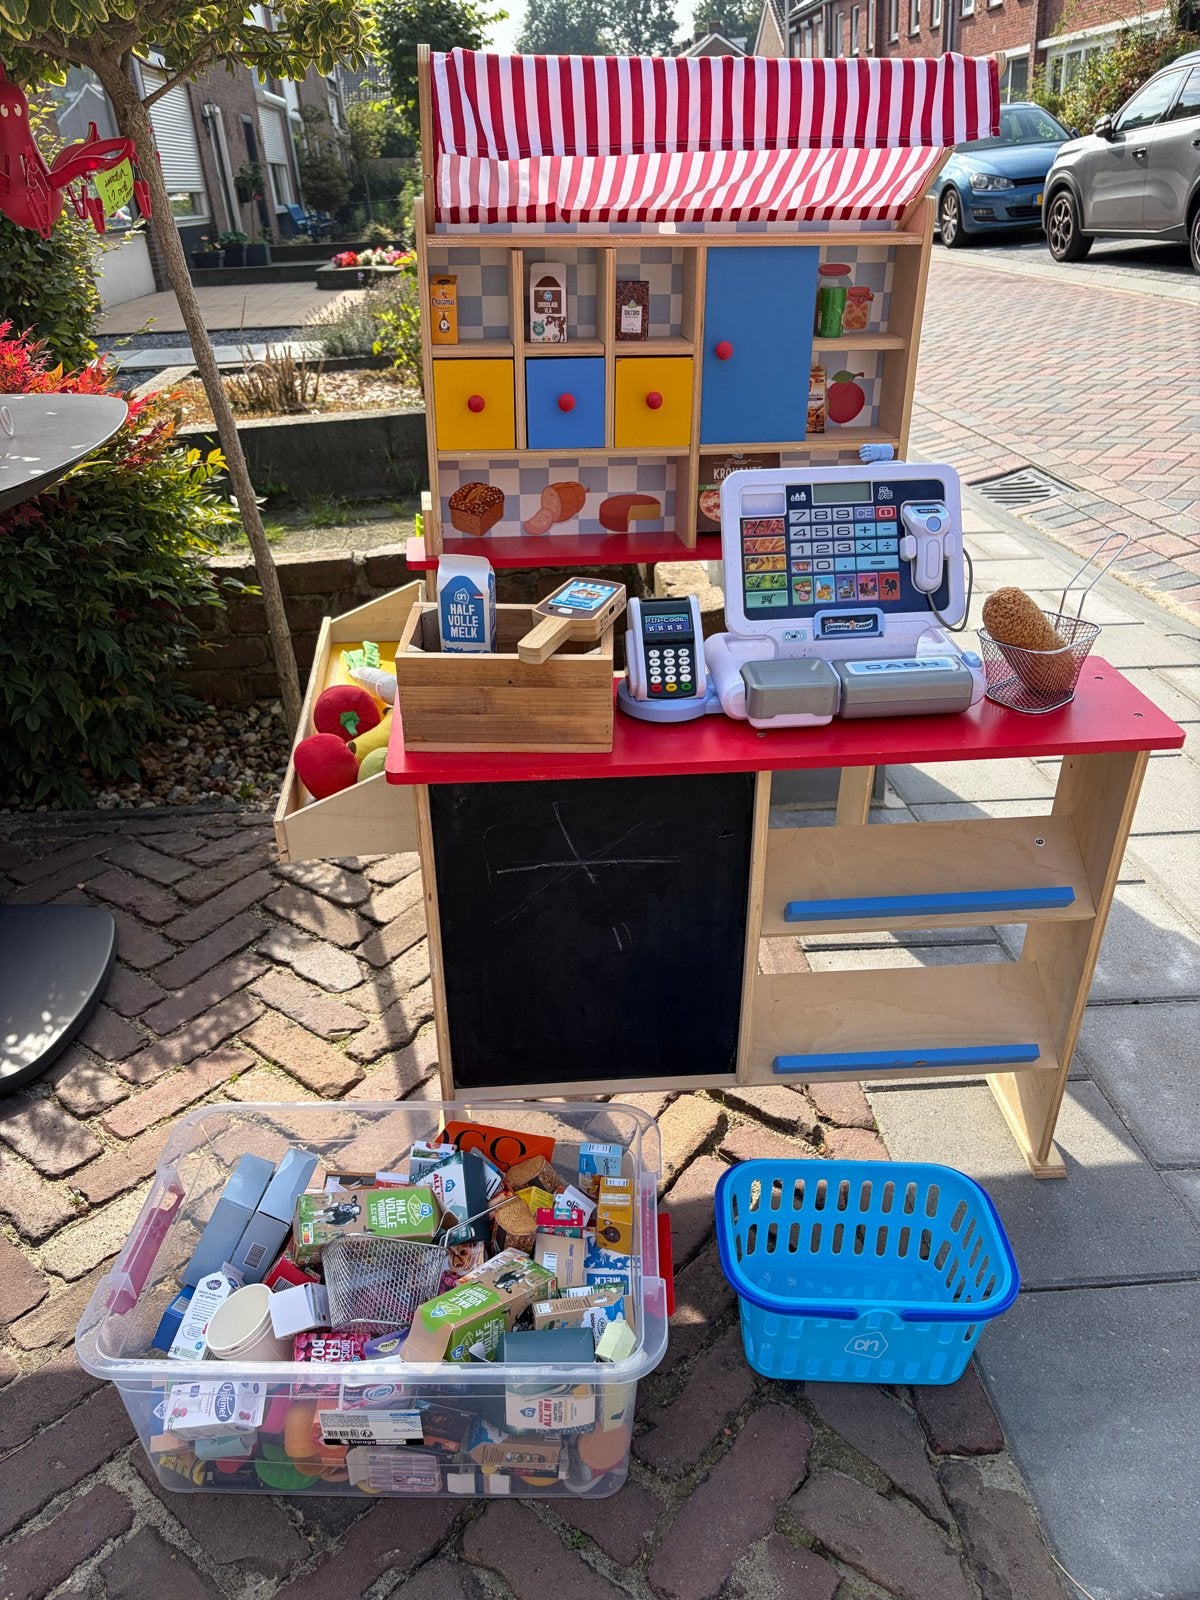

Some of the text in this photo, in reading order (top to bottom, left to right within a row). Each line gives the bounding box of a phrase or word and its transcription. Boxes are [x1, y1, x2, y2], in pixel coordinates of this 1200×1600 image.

[856, 508, 873, 519] CE
[449, 603, 476, 616] HALF
[447, 615, 479, 627] VOLLE
[825, 620, 873, 632] Shopping Center
[450, 626, 478, 639] MELK
[864, 661, 940, 670] CASH
[377, 1198, 387, 1229] YOGHURT
[385, 1197, 398, 1229] VOLLE
[395, 1199, 408, 1225] HALF
[370, 1215, 378, 1226] VET
[310, 1339, 326, 1363] BOZ
[341, 1339, 351, 1362] DOOSJ
[543, 1402, 552, 1412] IN
[543, 1412, 552, 1427] ALL
